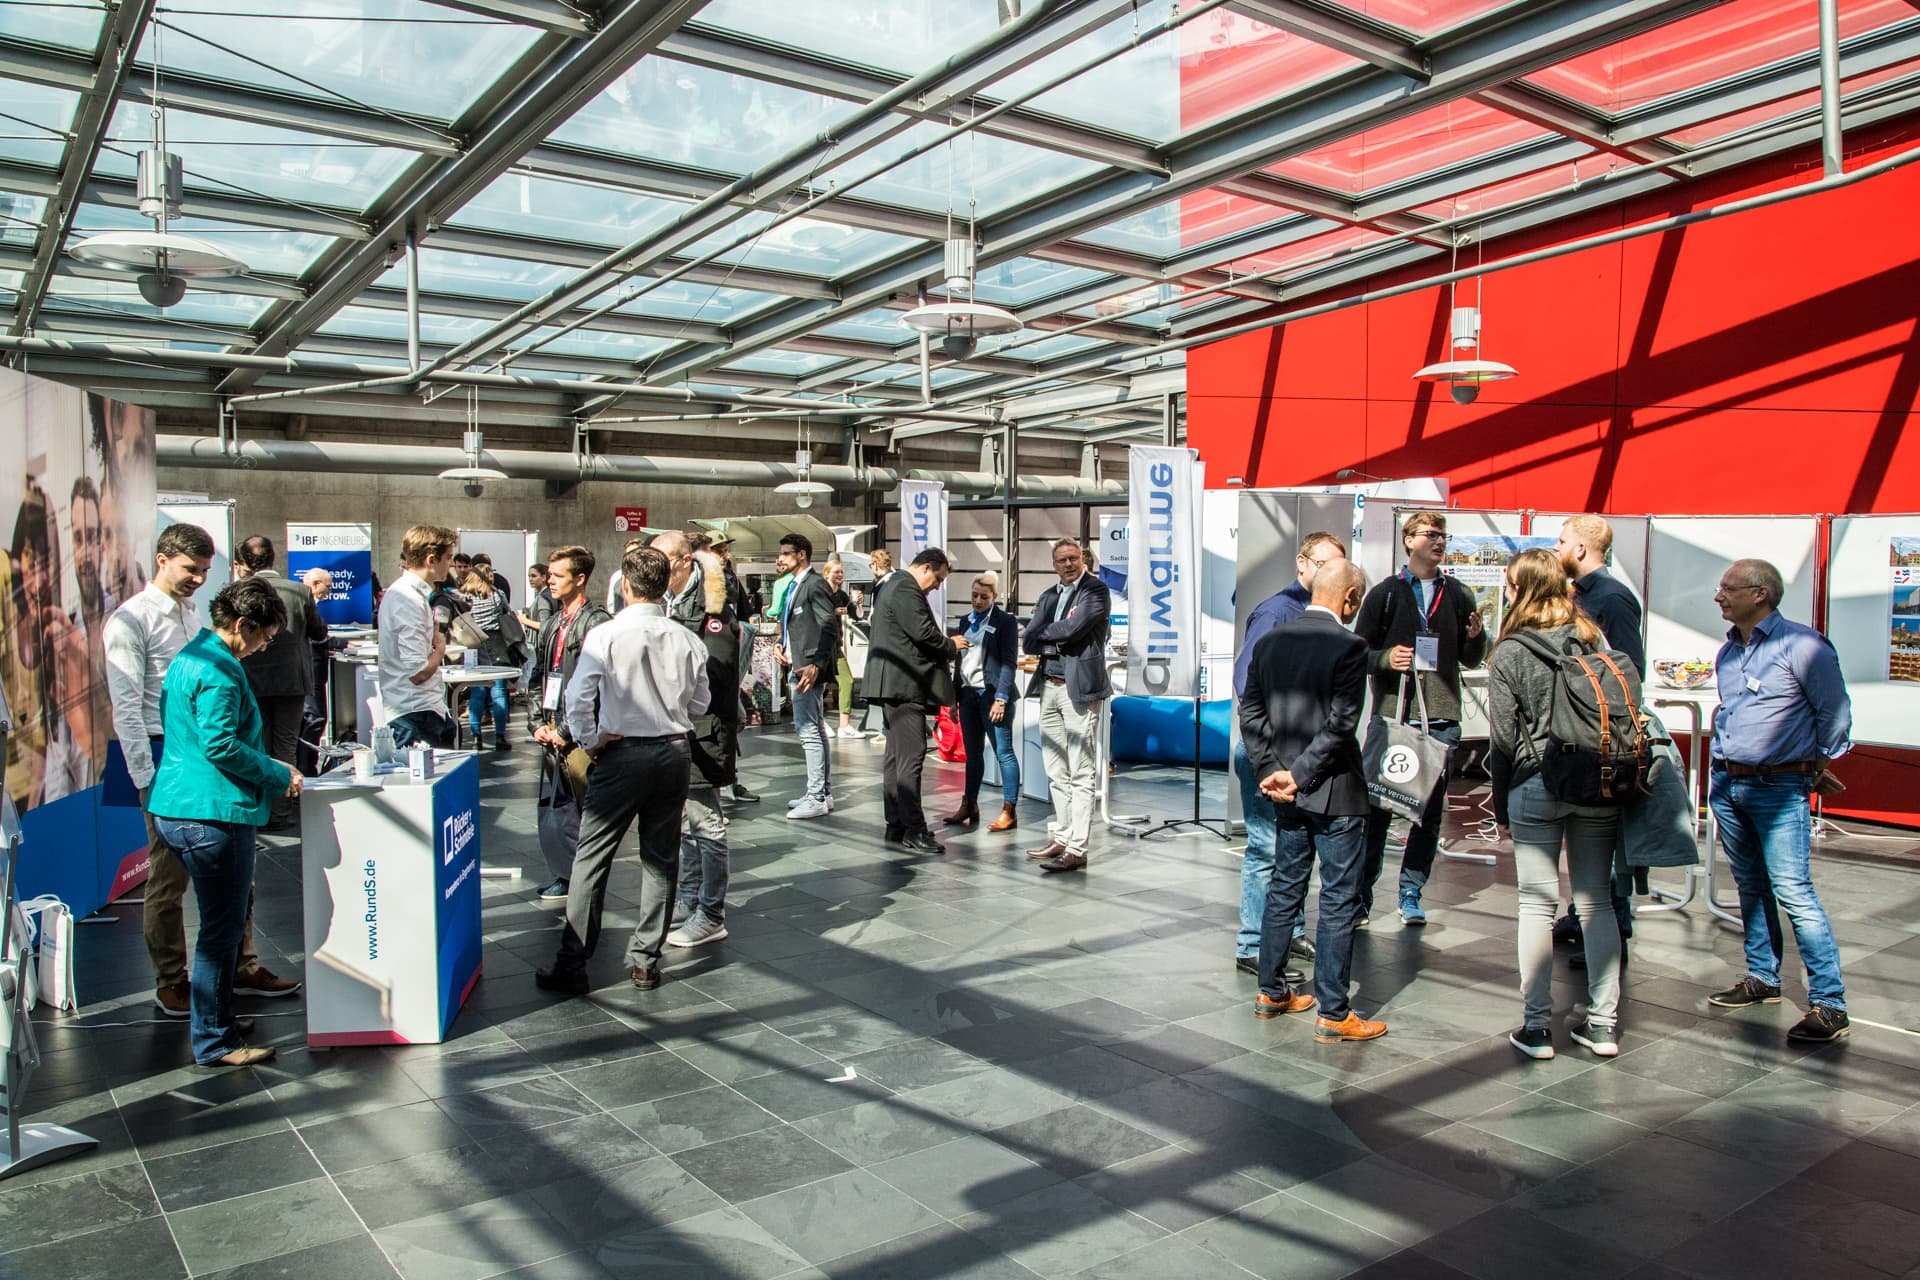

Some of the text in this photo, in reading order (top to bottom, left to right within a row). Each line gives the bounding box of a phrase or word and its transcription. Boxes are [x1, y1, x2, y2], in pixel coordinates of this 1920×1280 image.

[302, 536, 318, 546] IBF
[328, 569, 355, 580] eady.
[330, 580, 353, 591] udy.
[1367, 782, 1387, 793] ergie
[364, 859, 378, 960] www.RundS.de
